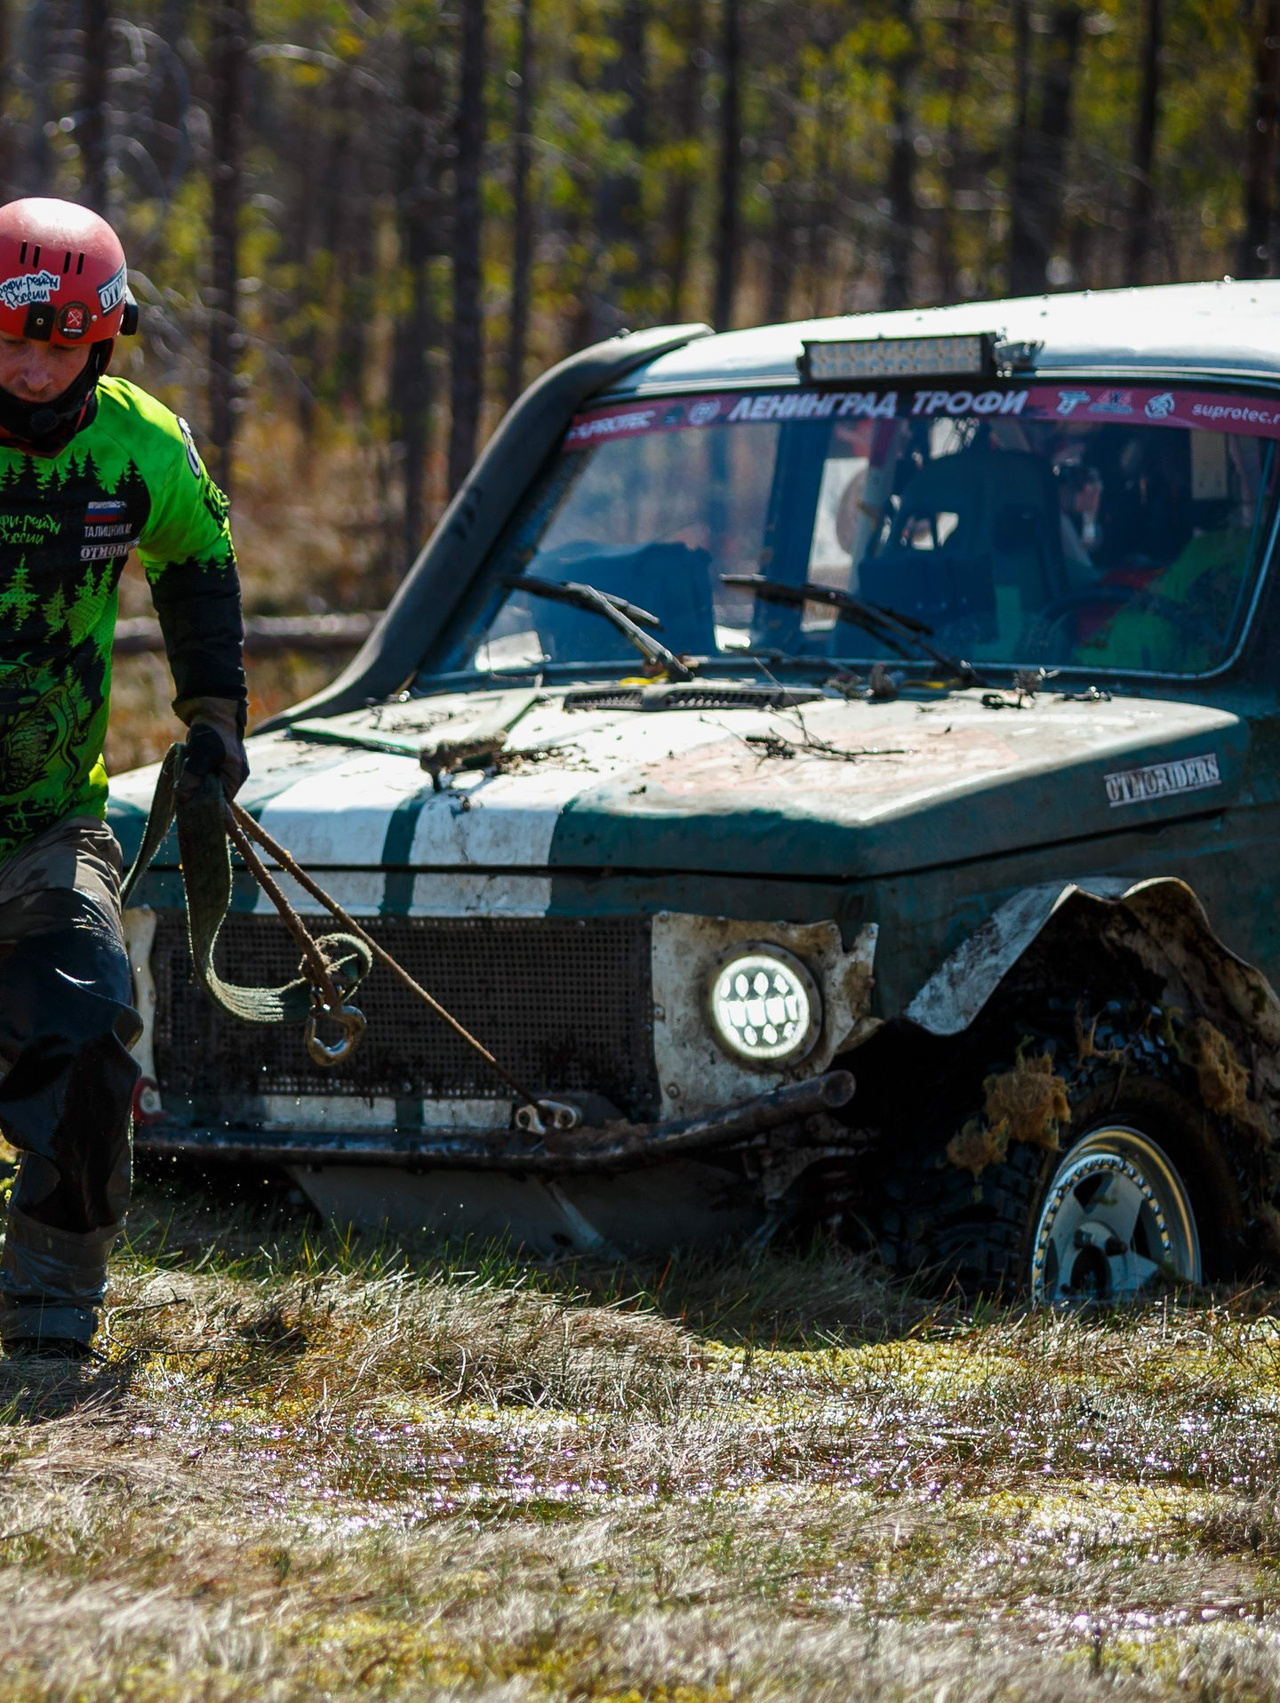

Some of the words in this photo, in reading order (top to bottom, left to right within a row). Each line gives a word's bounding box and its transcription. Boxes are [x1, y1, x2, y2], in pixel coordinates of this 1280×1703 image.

[728, 391, 898, 423] ЛЕНИНГРАД
[911, 391, 1030, 416] ТРОФИ
[1106, 758, 1220, 801] OTMORIDERS
